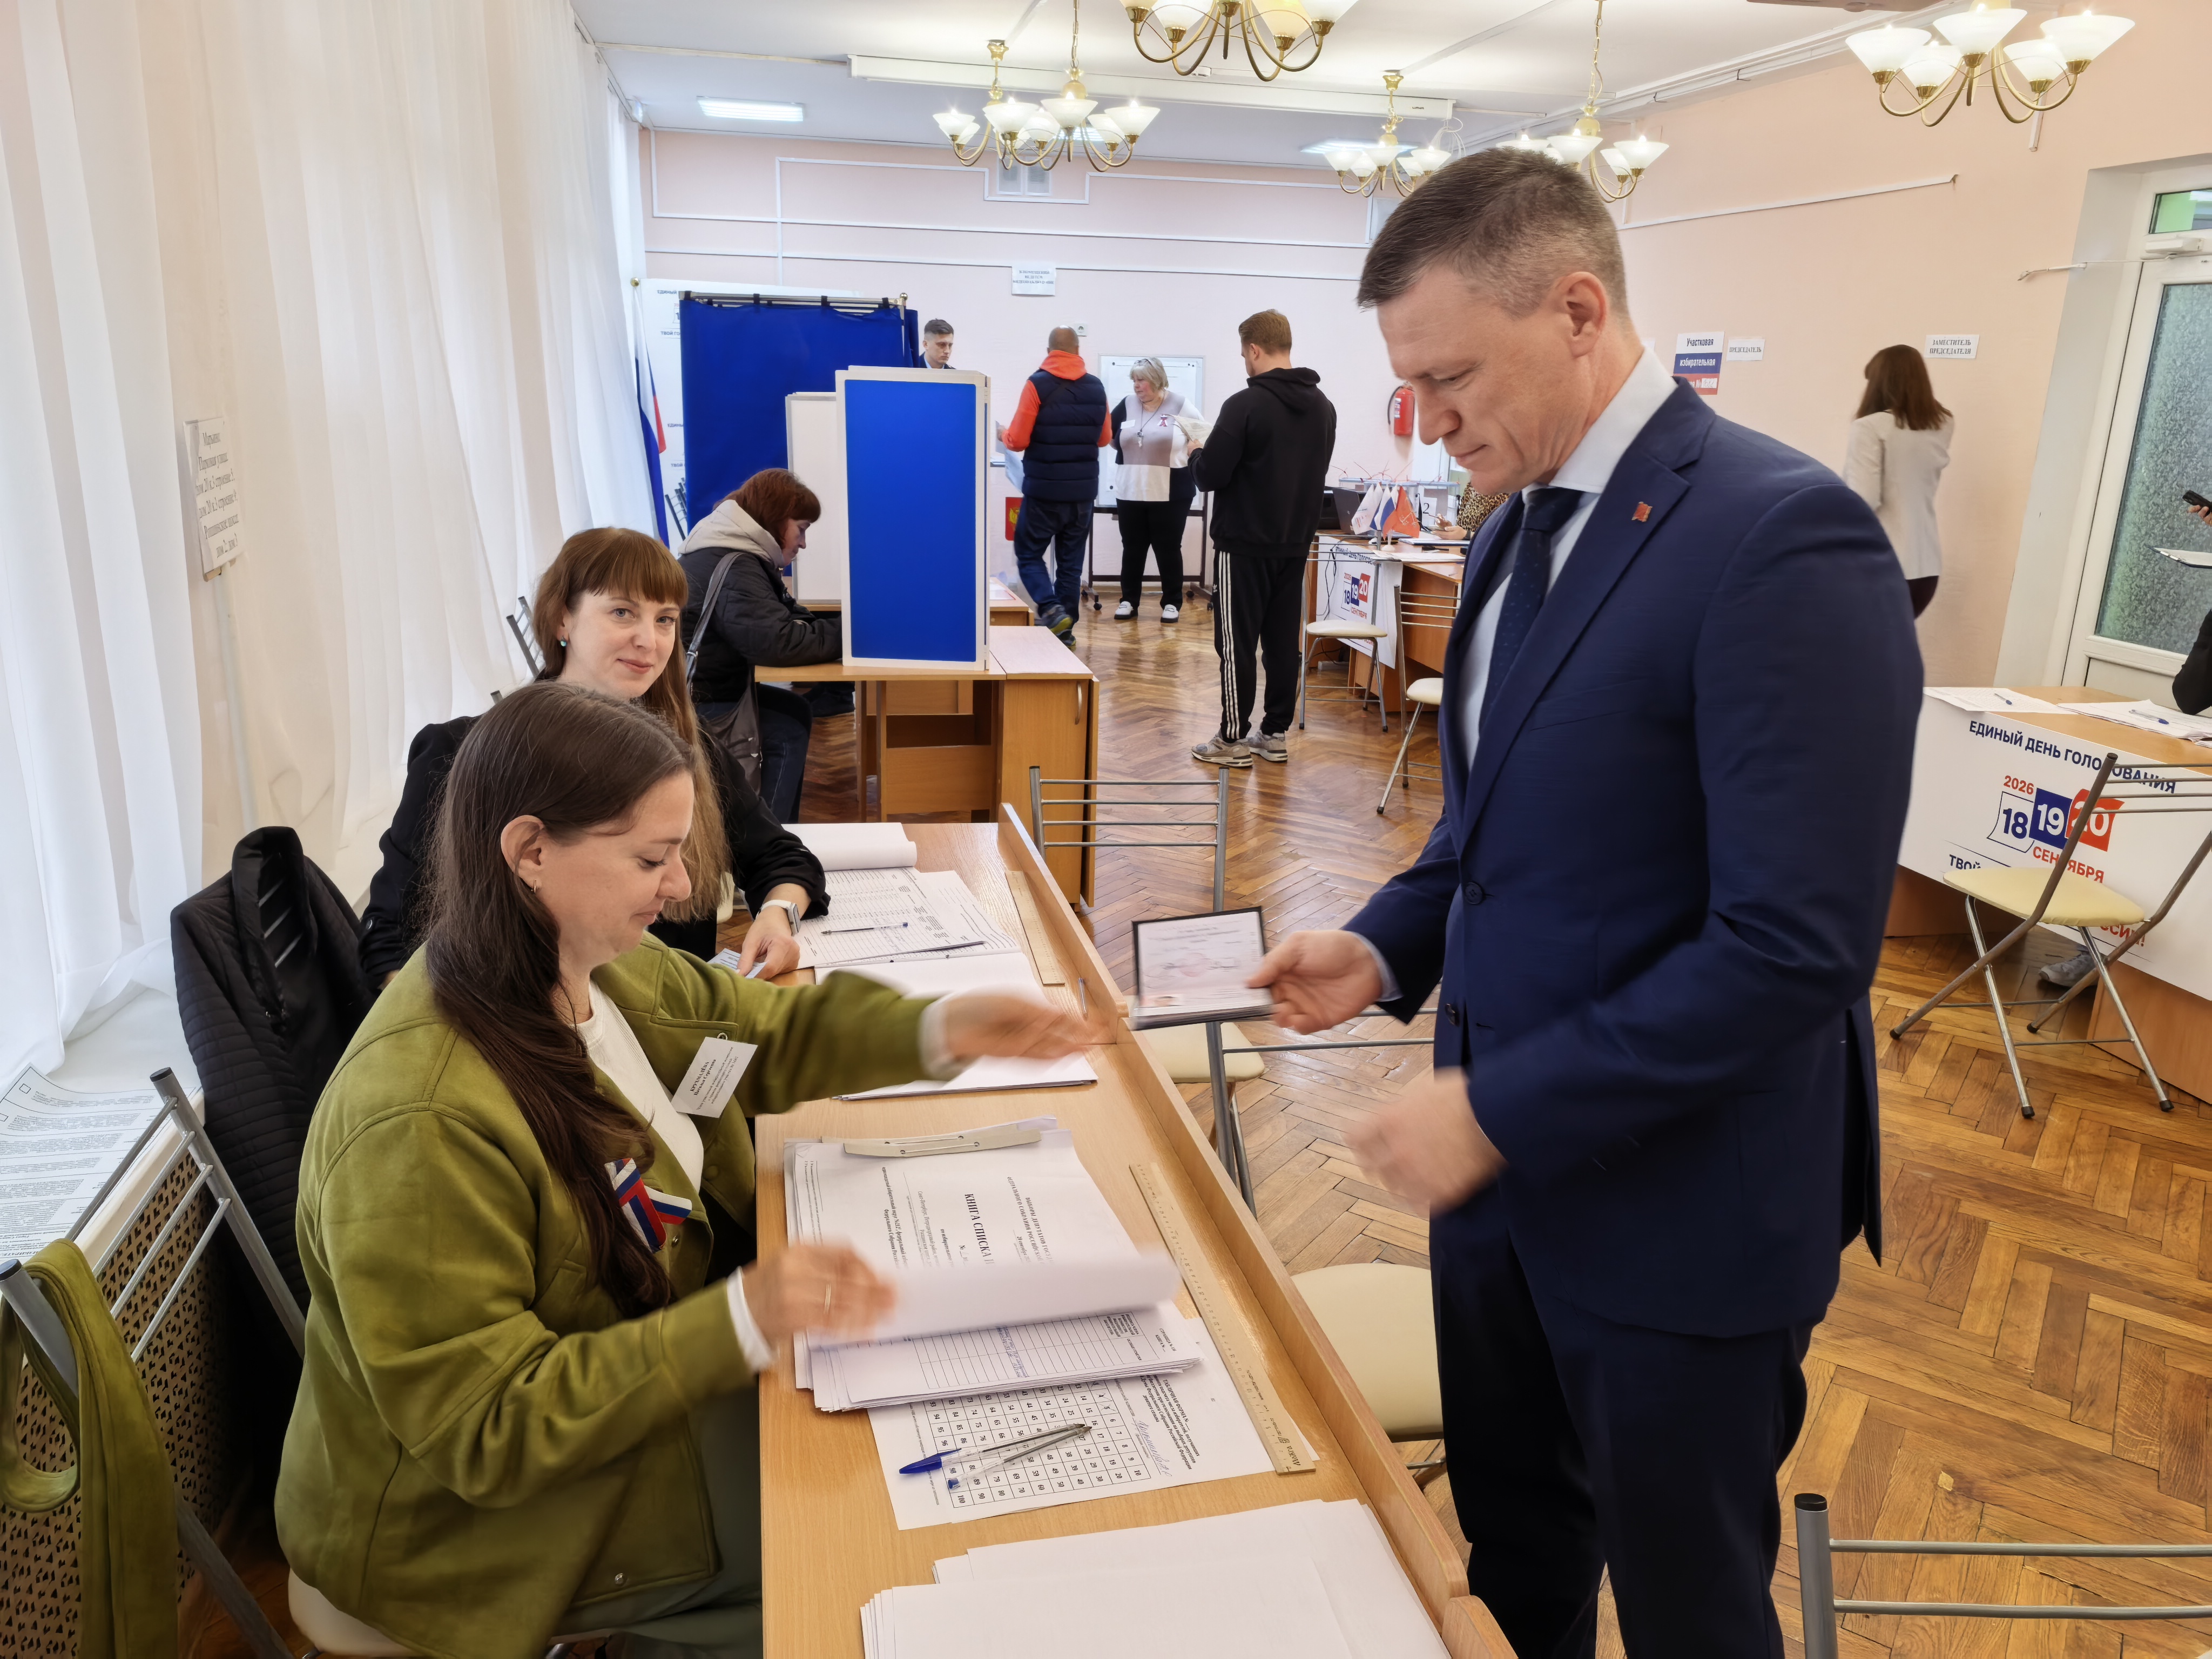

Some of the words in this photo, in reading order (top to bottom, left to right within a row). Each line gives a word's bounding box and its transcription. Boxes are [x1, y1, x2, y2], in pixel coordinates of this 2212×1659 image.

[1687, 338, 1714, 347] Участковая
[1680, 358, 1716, 368] избирательная
[1422, 503, 1429, 514] 2
[1344, 589, 1350, 605] 18
[1352, 584, 1358, 600] 19
[1359, 579, 1368, 596] 20
[1969, 720, 2023, 747] ЕДИНЫЙ
[2025, 738, 2061, 758] ДЕНЬ
[2065, 749, 2176, 794] ГОЛООВАНИЯ
[2004, 775, 2034, 795] 2026
[2002, 807, 2028, 840] 18
[2037, 804, 2065, 836] 19
[2033, 846, 2105, 884] СЕНЯБРЯ
[690, 1061, 710, 1092] КРУХМАЛЁВА
[703, 1059, 716, 1079] Сергеевна
[1007, 1176, 1022, 1205] ФЕДЕРАЛЬНОГО
[1019, 1206, 1031, 1230] СОБРАНИЯ
[965, 1193, 981, 1220] КНИГА
[973, 1223, 992, 1257] СПИСКА
[1026, 1197, 1036, 1216] ВЫБОРЫ
[1031, 1217, 1046, 1245] ДЕПУТАТОВ
[1163, 1379, 1179, 1404] ТАБЛИЧНАЯ
[1176, 1403, 1187, 1419] ФОРМА
[1287, 1446, 1301, 1466] Можга
[957, 1495, 966, 1503] 100
